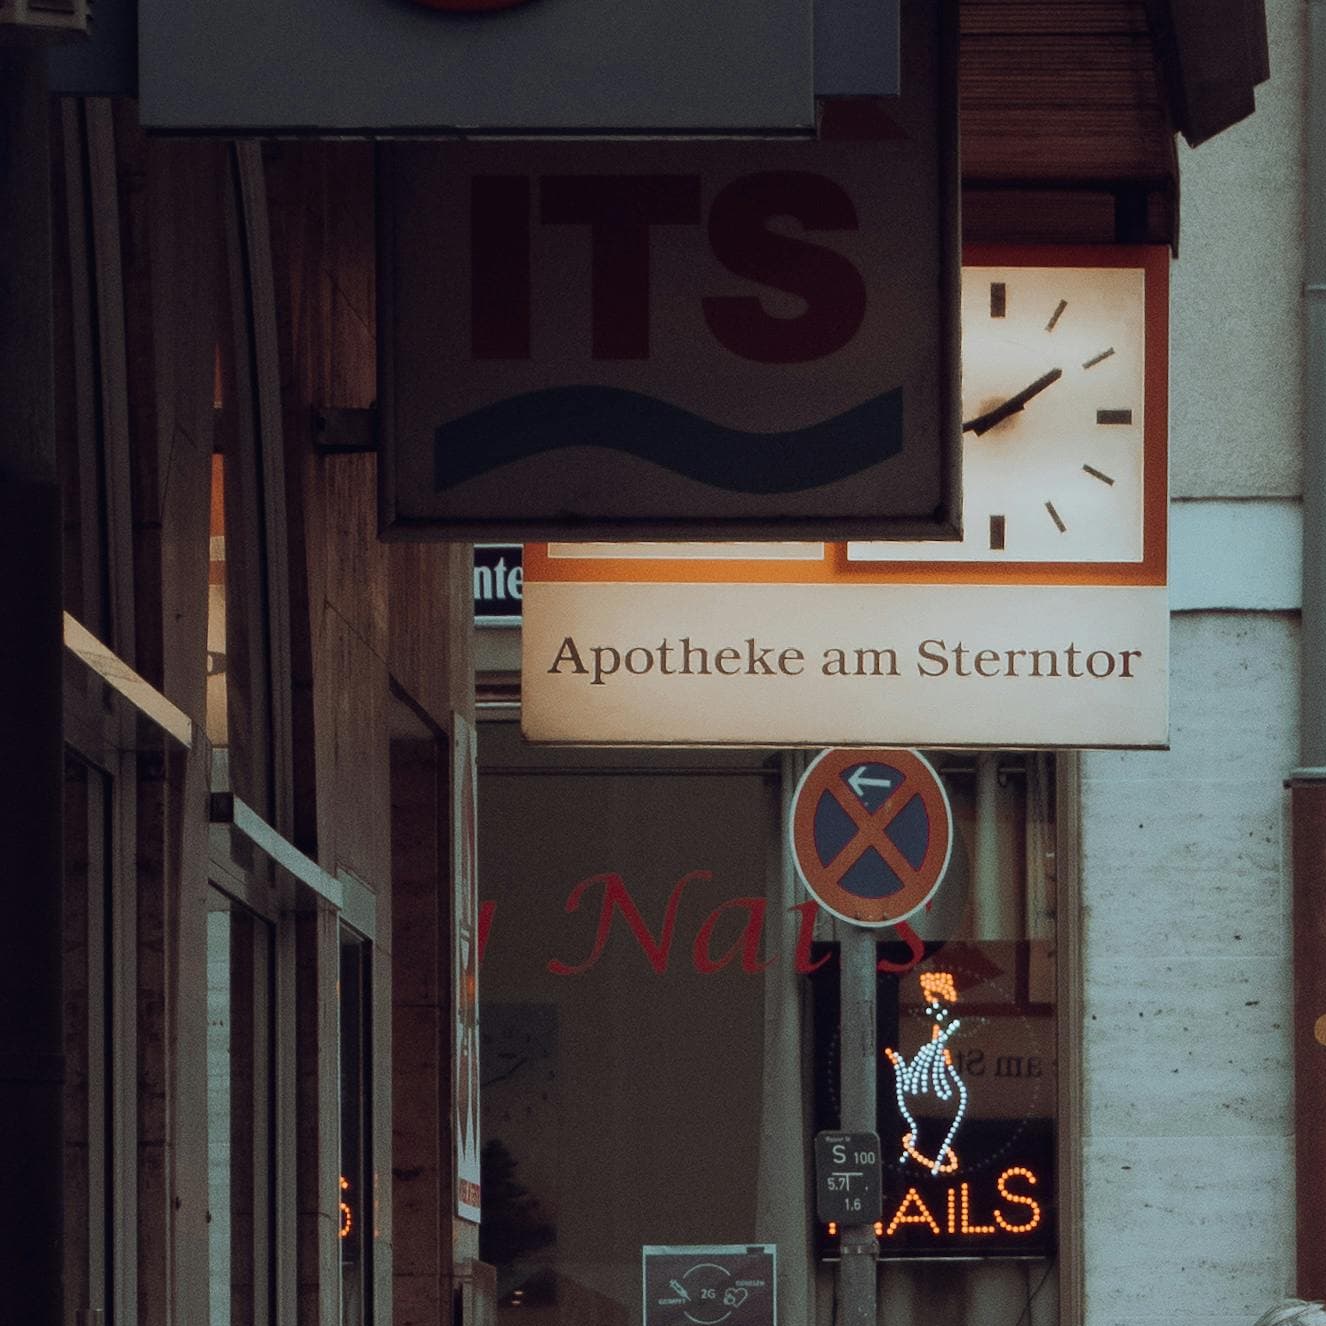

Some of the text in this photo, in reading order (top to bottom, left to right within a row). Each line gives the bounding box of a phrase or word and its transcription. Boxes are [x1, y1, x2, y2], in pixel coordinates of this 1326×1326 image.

[470, 169, 867, 364] ITS
[547, 636, 1142, 685] Apotheke am Sterntor
[832, 1144, 876, 1165] S 100
[827, 1166, 1042, 1236] AILS
